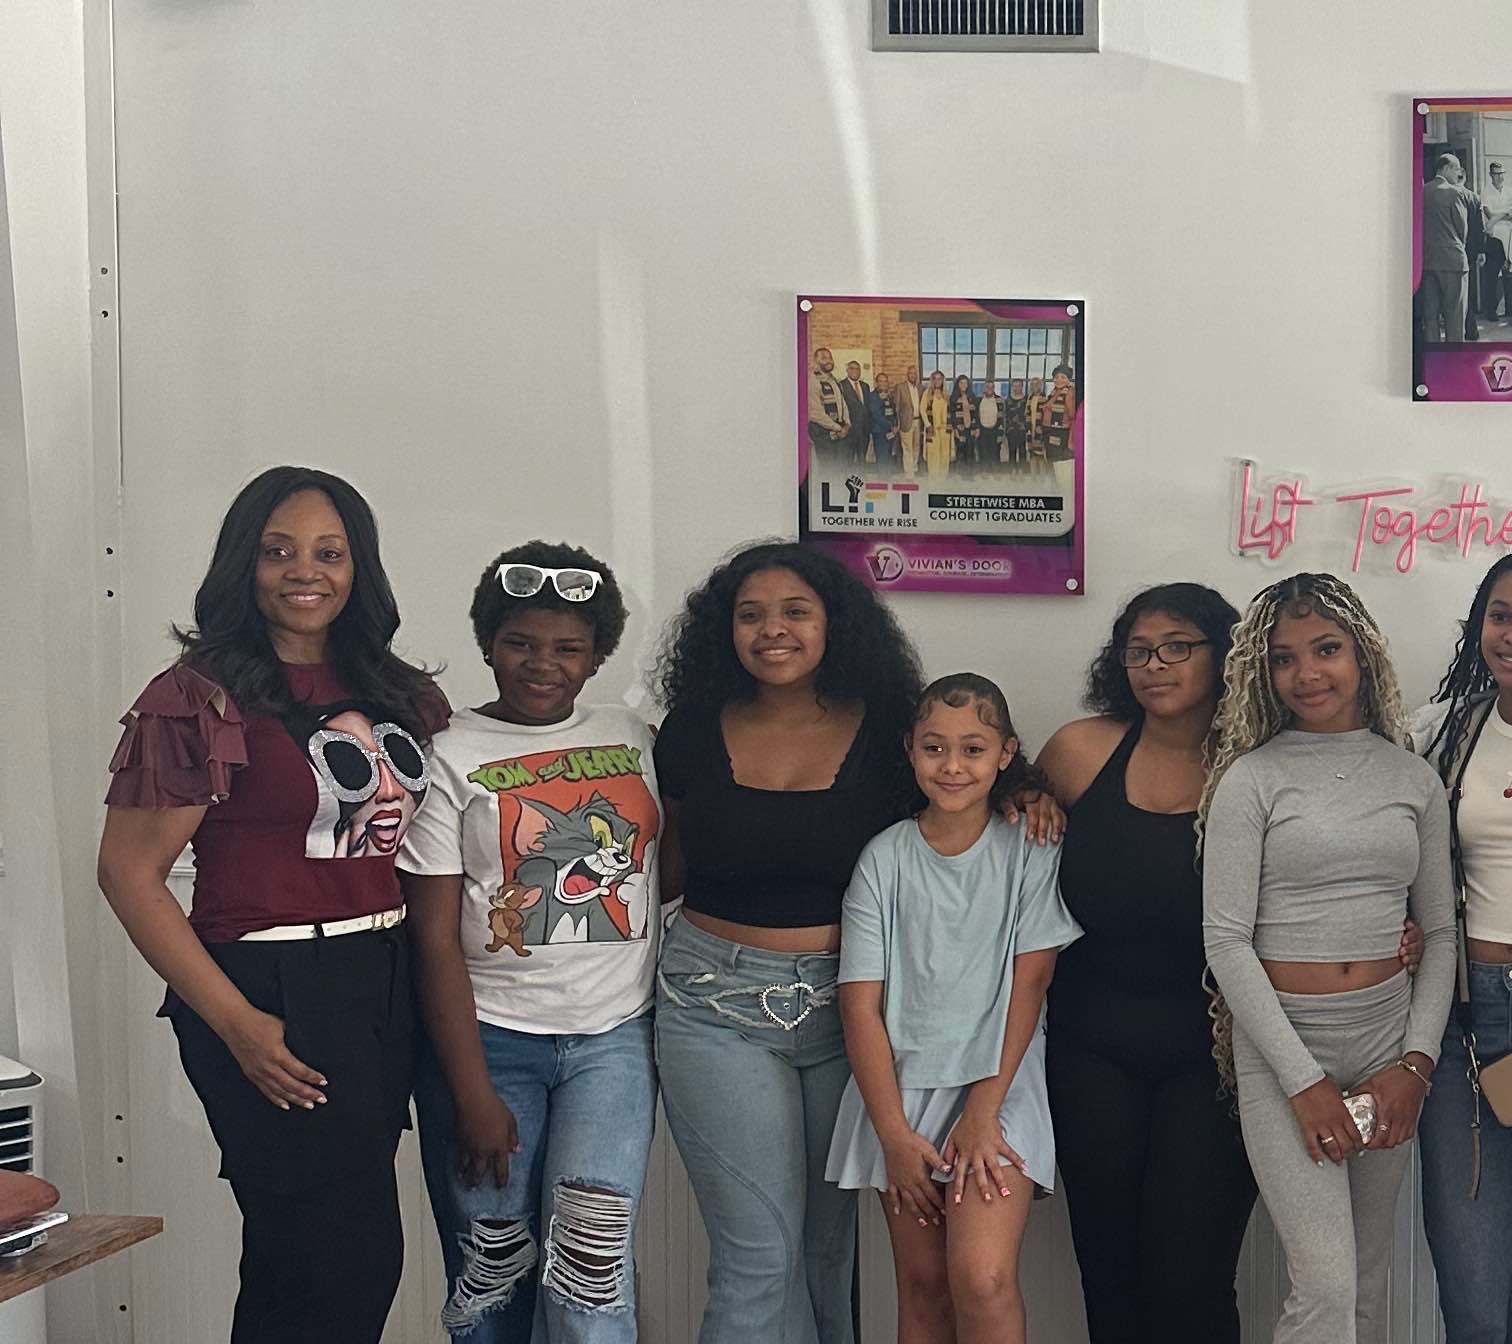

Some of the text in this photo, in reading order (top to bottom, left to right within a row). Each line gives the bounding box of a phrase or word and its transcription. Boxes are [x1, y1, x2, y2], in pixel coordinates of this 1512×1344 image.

[946, 496, 1046, 510] STREETWISE MBA
[821, 517, 918, 528] TOGETHER WE RISE
[929, 510, 981, 522] COHORT
[908, 558, 1009, 572] VIVIAN'S DOOR
[466, 760, 537, 792] TOM
[561, 746, 643, 782] JERRY
